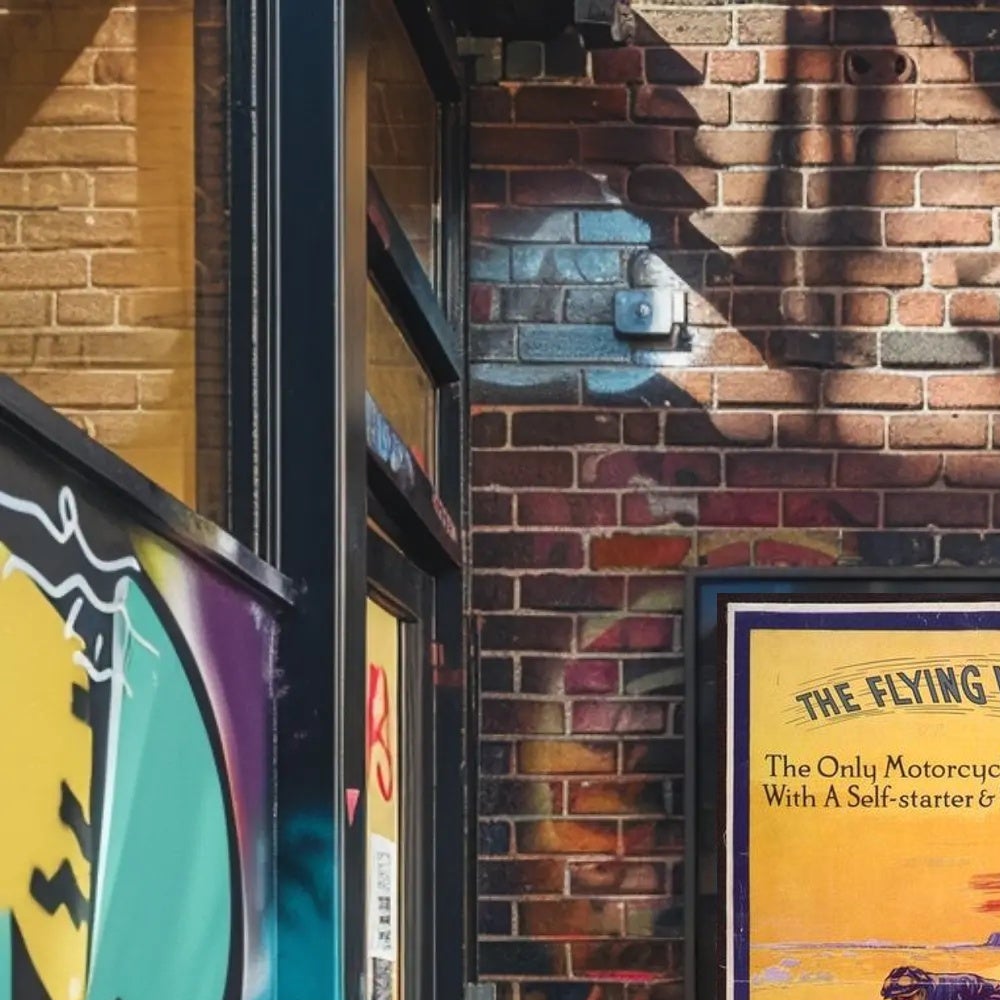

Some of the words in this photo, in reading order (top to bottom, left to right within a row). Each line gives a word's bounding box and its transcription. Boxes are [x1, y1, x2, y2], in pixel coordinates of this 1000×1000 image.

[796, 682, 861, 721] THE
[865, 664, 987, 708] FLYING
[764, 754, 811, 780] The
[818, 754, 876, 783] Only
[763, 784, 815, 808] With
[823, 784, 841, 808] A
[847, 784, 973, 808] Self-starter
[978, 787, 996, 808] &
